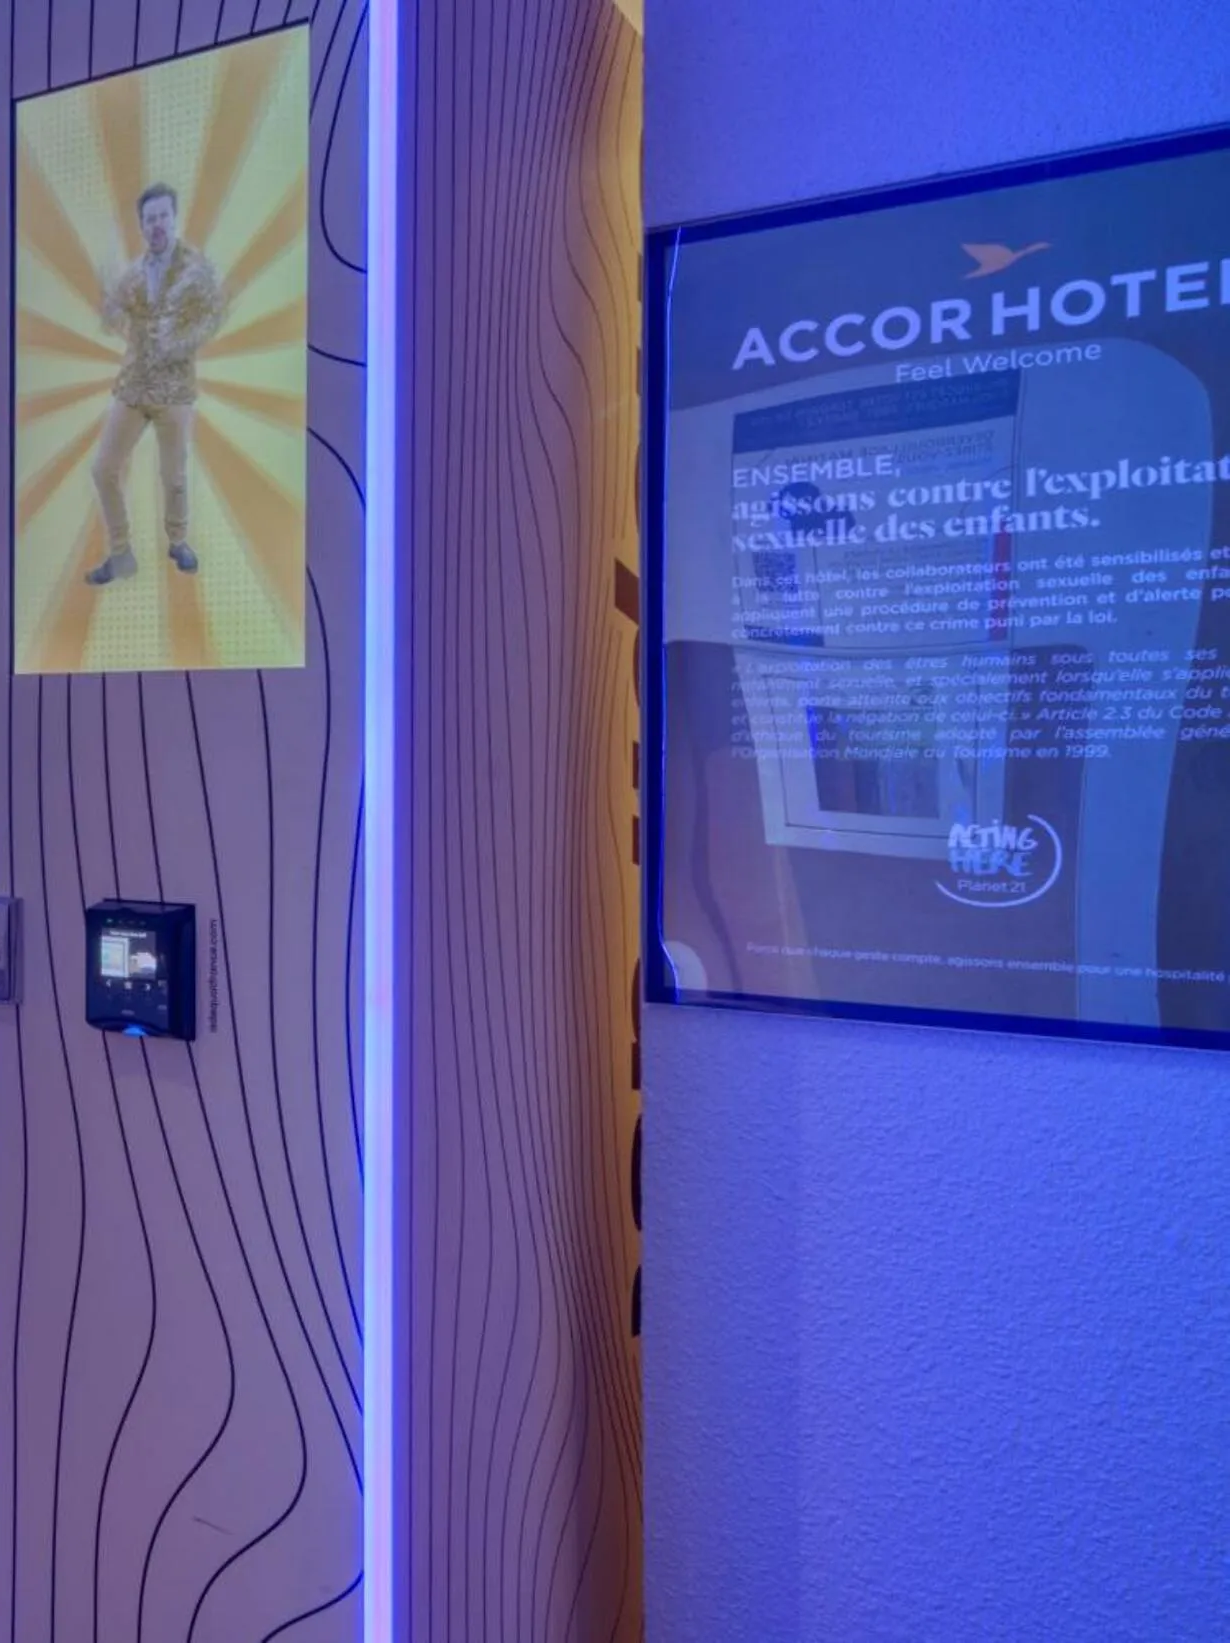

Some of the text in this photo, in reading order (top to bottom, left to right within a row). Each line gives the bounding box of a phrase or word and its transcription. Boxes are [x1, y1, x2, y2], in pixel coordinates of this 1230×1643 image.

[895, 342, 1103, 384] Feel Welcome
[732, 453, 902, 489] ENSEMBLE,
[731, 489, 876, 528] agissons
[887, 476, 1012, 507] contre
[731, 503, 1101, 552] sexuelle des enfants.
[731, 575, 769, 589] Dans
[775, 574, 801, 586] cet
[856, 567, 879, 581] les
[885, 559, 1011, 582] collaborateurs
[1016, 557, 1048, 573] ont
[1053, 553, 1085, 570] été
[1091, 546, 1203, 568] sensibilisés
[755, 589, 769, 604] la
[782, 587, 821, 604] lutte
[835, 585, 890, 600] contre
[905, 575, 1020, 598] l'exploitation
[1036, 571, 1114, 590] sexuelle
[1131, 568, 1168, 584] des
[731, 606, 817, 625] appliquent
[823, 603, 854, 619] une
[860, 598, 950, 618] procédure
[957, 596, 980, 611] de
[987, 592, 1088, 612] prévention
[1096, 591, 1116, 604] et
[1124, 586, 1203, 604] d'alerte
[845, 616, 901, 634] contre
[904, 618, 925, 632] ce
[929, 614, 979, 631] crime
[984, 614, 1024, 631] puni
[1029, 613, 1060, 629] par
[1066, 609, 1083, 625] la
[1088, 608, 1118, 624] loi.
[863, 657, 892, 671] des
[904, 655, 949, 671] êtres
[961, 652, 1037, 668] humains
[1050, 651, 1095, 666] sous
[1108, 648, 1171, 664] toutes
[1183, 647, 1219, 662] ses
[905, 675, 923, 689] et
[930, 670, 1049, 690] spécialement
[1054, 667, 1154, 686] lorsqu'elle
[915, 692, 949, 706] aux
[955, 688, 1034, 706] objectifs
[1038, 686, 1178, 703] fondamentaux
[1184, 685, 1214, 700] du
[845, 709, 921, 728] négation
[923, 708, 947, 724] de
[1035, 705, 1100, 722] Article
[1137, 703, 1164, 720] du
[1169, 702, 1223, 720] Code
[815, 728, 837, 742] du
[847, 727, 921, 743] tourisme
[934, 725, 998, 744] adopté
[1009, 727, 1042, 744] par
[1053, 724, 1167, 741] l'assemblée
[842, 743, 921, 761] Mondiale
[923, 744, 947, 759] du
[952, 743, 1033, 760] Tourisme
[1035, 745, 1060, 759] en
[947, 848, 1035, 877] HERE
[957, 878, 1028, 894] Planet 21
[1006, 959, 1074, 974] ensemble
[1114, 965, 1144, 977] une
[1144, 965, 1226, 984] hospitalité
